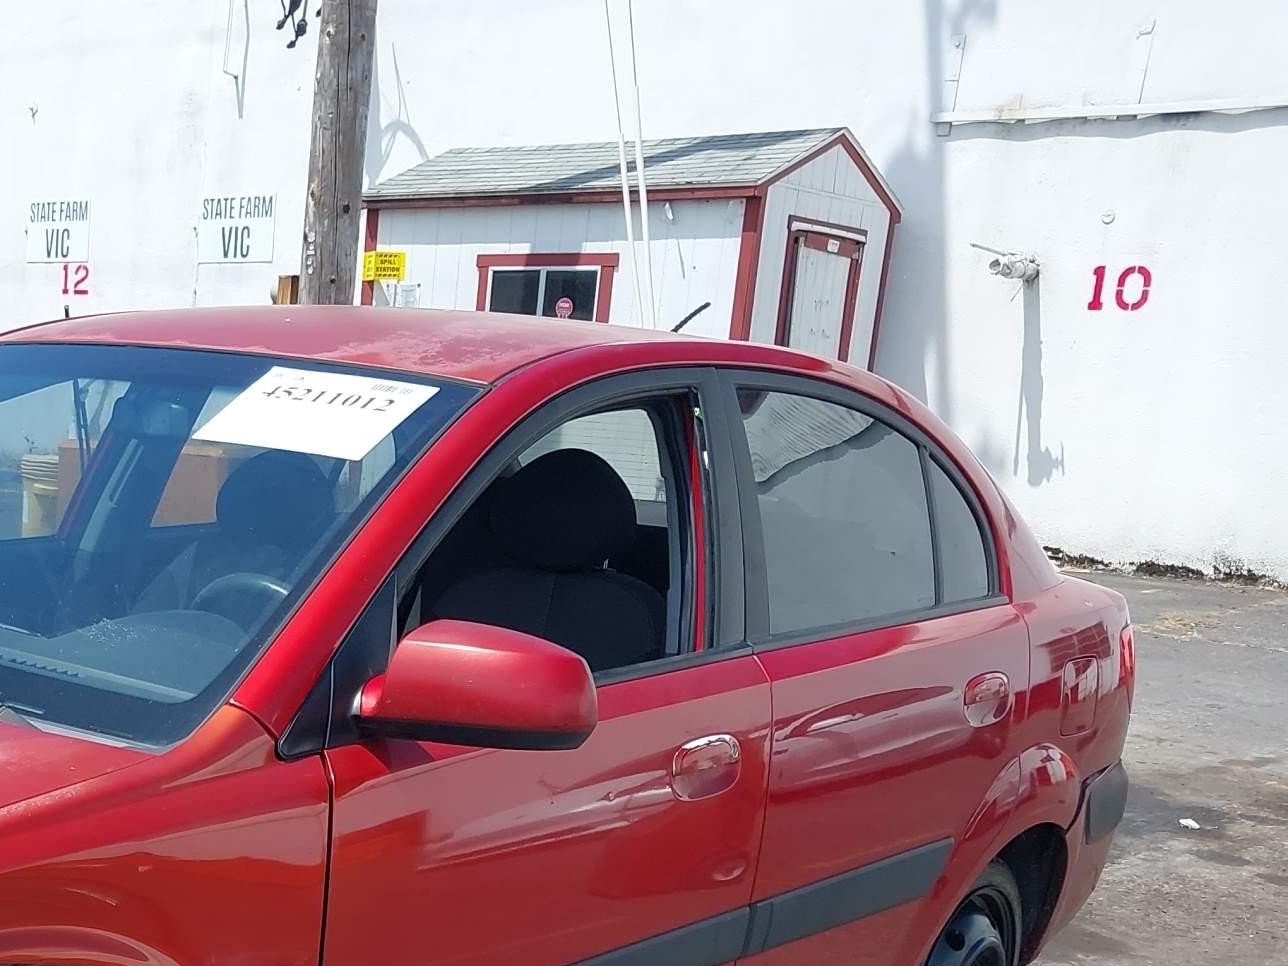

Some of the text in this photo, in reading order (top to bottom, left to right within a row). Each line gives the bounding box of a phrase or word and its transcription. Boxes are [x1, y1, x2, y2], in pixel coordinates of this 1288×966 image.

[30, 200, 89, 223] STATE FARM
[203, 195, 273, 220] STATE FARM
[45, 228, 70, 259] VIC
[222, 226, 250, 259] VIC
[62, 264, 89, 295] 12
[1087, 265, 1152, 311] 10
[262, 385, 395, 412] 45211012
